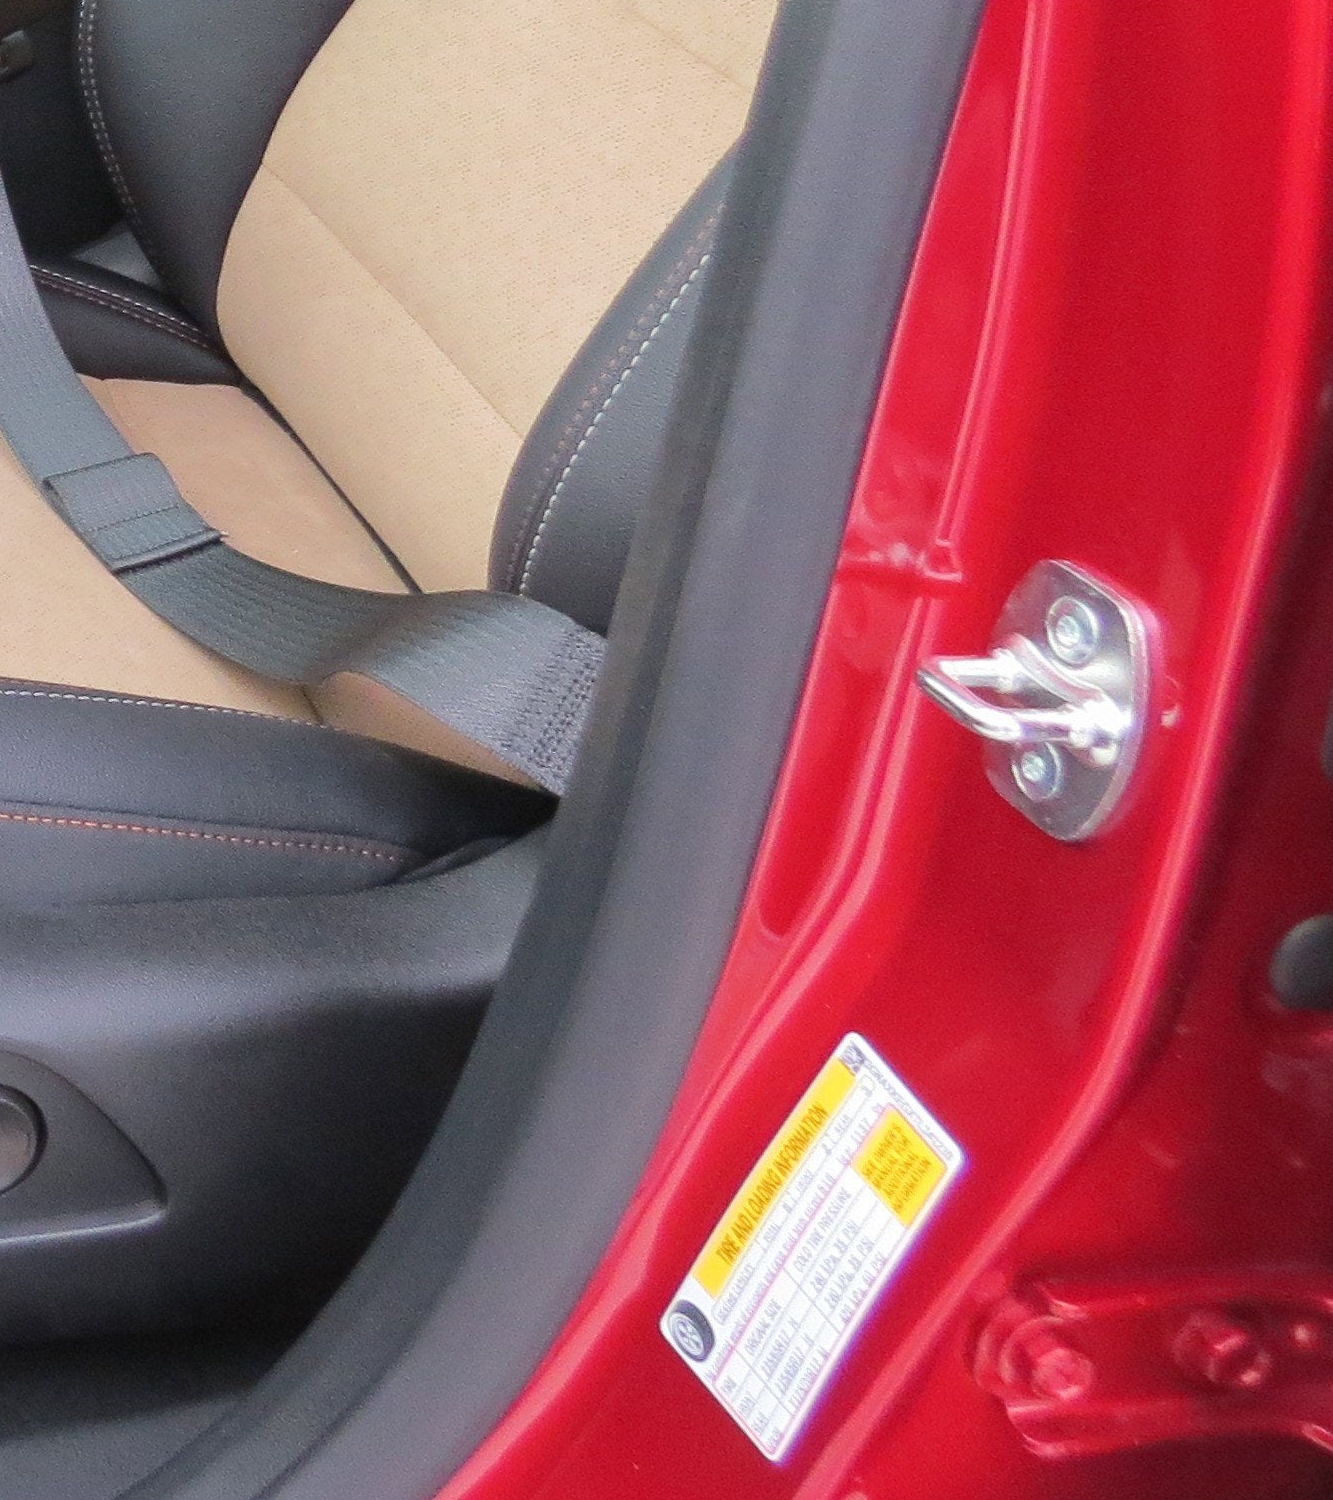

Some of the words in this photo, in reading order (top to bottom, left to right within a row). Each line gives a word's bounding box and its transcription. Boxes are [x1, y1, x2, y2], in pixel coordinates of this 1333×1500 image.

[715, 1234, 740, 1267] TIRE
[730, 1210, 755, 1245] AND
[744, 1166, 783, 1222] LOADING
[772, 1098, 829, 1180] INFORMATION
